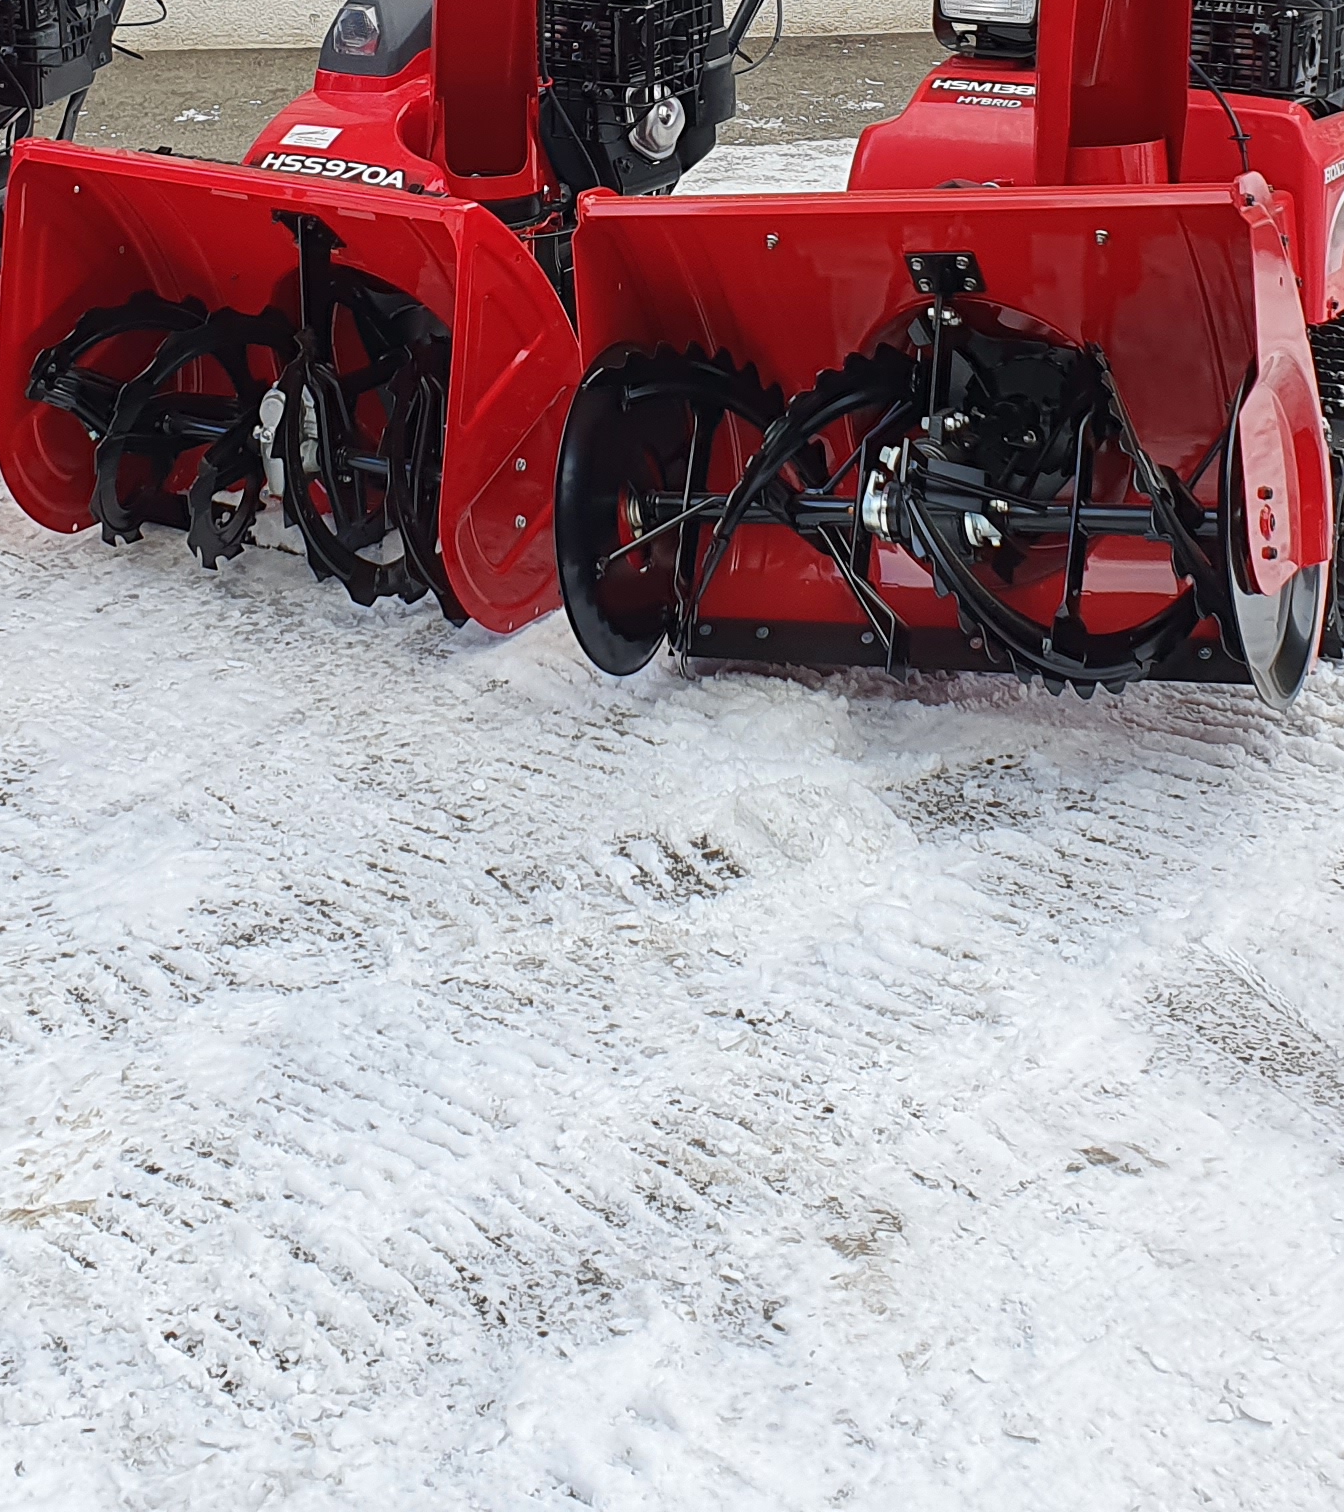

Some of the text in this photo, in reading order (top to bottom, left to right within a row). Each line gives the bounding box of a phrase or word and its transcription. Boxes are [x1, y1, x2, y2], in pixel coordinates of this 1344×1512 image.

[932, 79, 1036, 95] HSM138
[956, 96, 1022, 108] HYBRID
[261, 153, 403, 188] HSS970A
